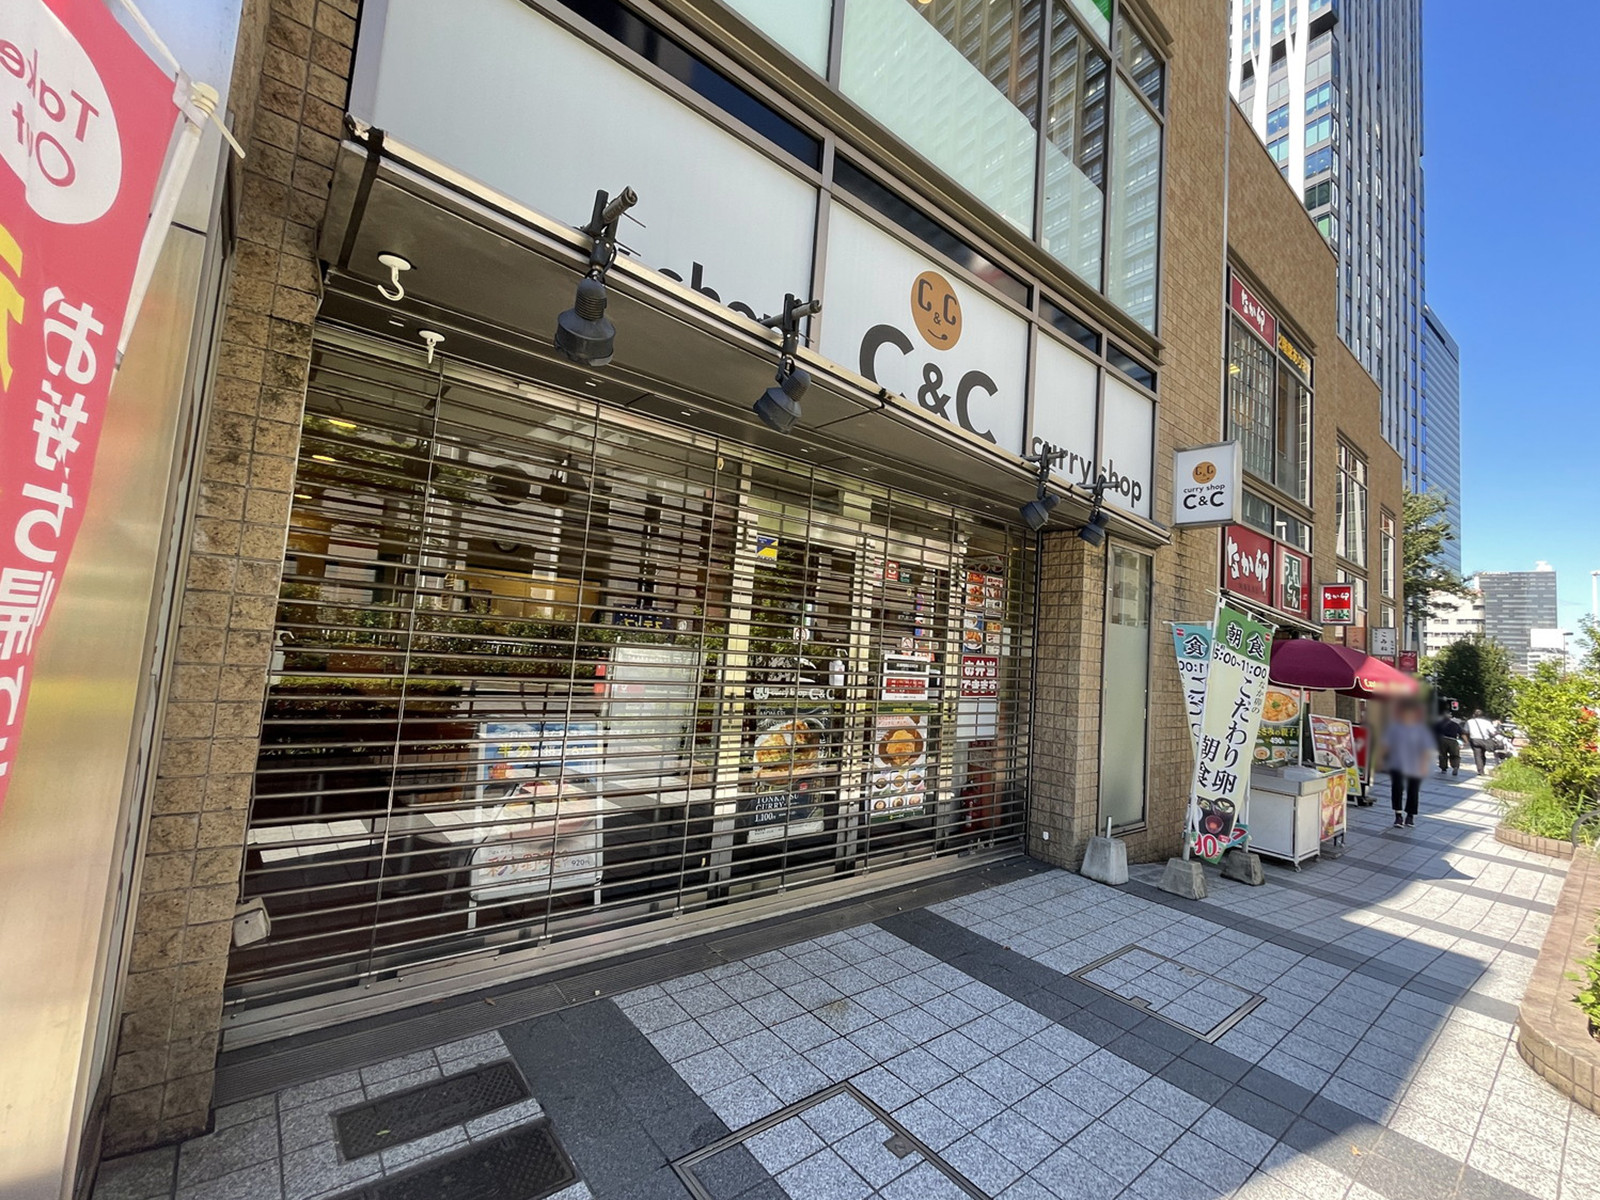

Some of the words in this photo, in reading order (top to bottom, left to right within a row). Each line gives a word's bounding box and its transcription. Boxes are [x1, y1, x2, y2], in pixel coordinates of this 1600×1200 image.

[859, 323, 999, 445] C&C
[1183, 486, 1204, 494] curry
[1183, 490, 1225, 510] C&C
[1227, 621, 1266, 660] 朝食
[963, 660, 996, 677] お弁当
[961, 679, 997, 693] できます
[757, 793, 799, 804] TONKASU
